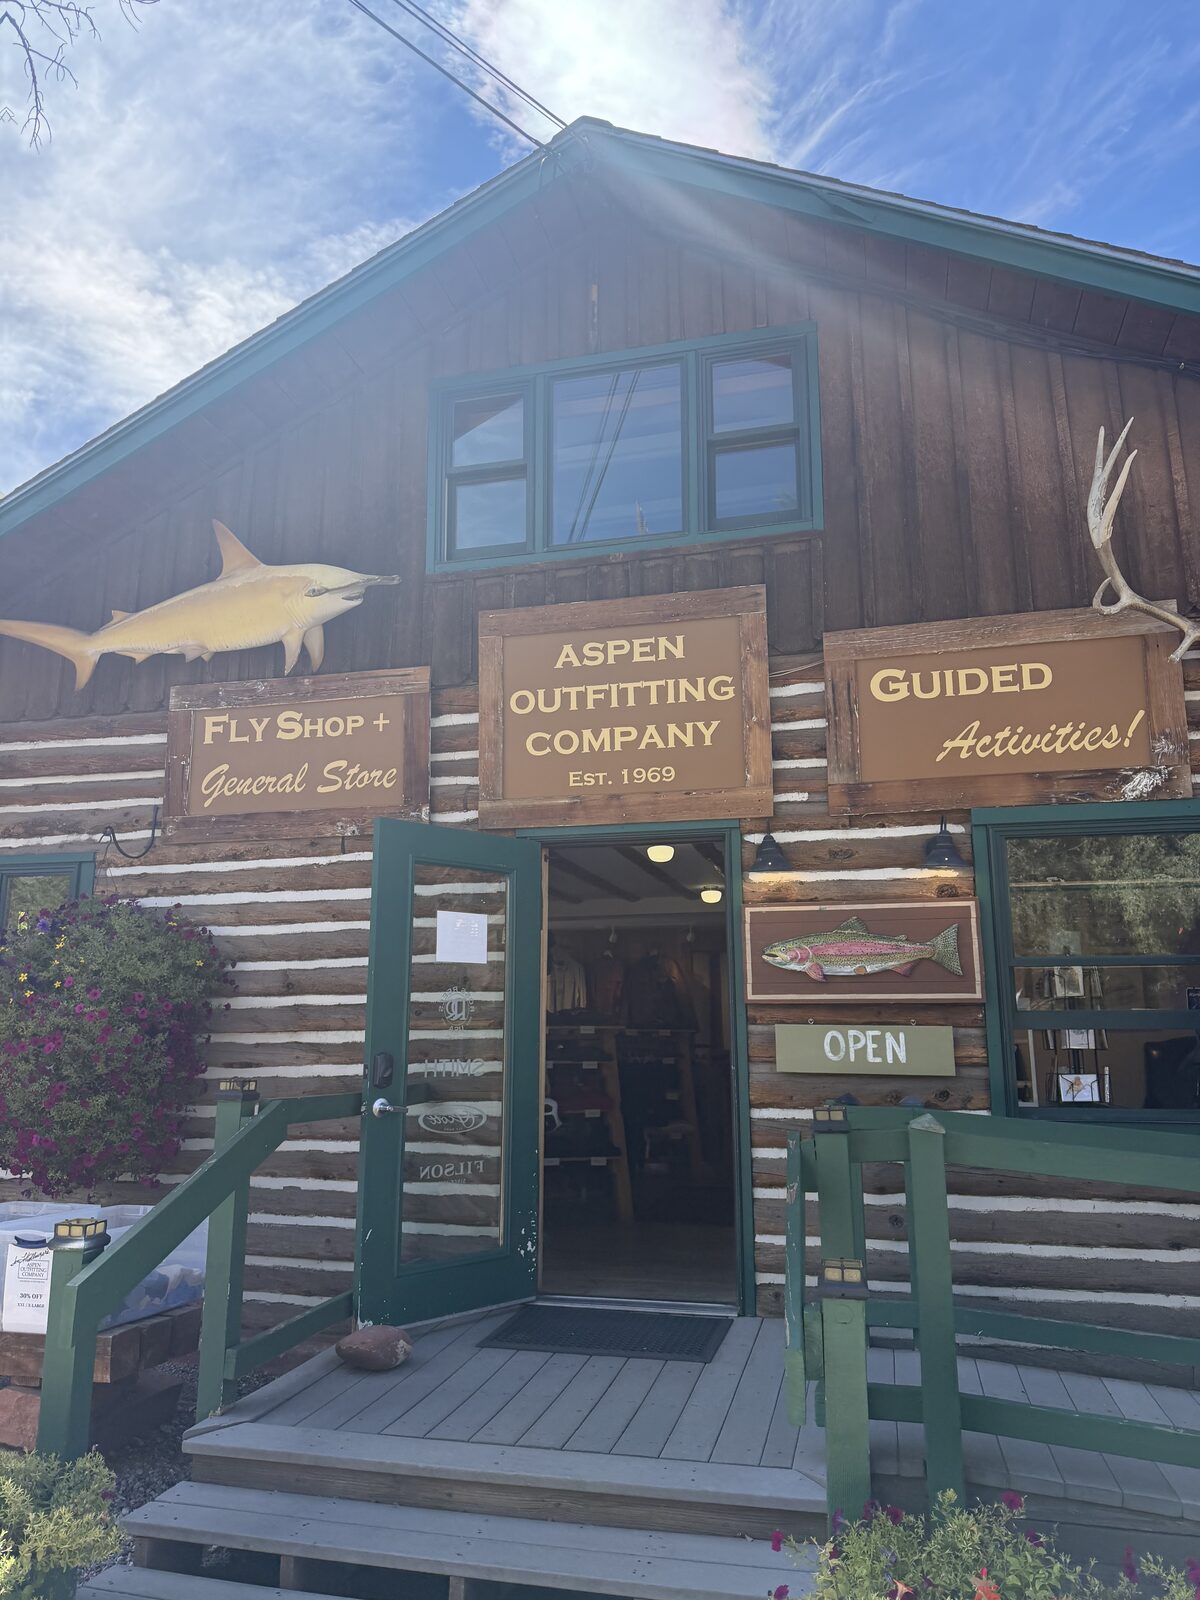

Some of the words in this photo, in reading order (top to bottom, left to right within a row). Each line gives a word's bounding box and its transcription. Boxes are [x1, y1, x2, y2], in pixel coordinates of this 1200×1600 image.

[553, 634, 685, 669] ASPEN
[509, 675, 736, 715] OUTFITTING
[869, 662, 1053, 703] GUIDED
[203, 713, 271, 745] FLY
[276, 710, 365, 740] SHOP
[525, 720, 721, 757] COMPANY
[936, 709, 1146, 762] Activities!
[201, 762, 309, 808] General
[317, 760, 397, 793] Store
[568, 771, 613, 787] EST.
[621, 766, 676, 784] 1969
[823, 1029, 907, 1064] OPEN
